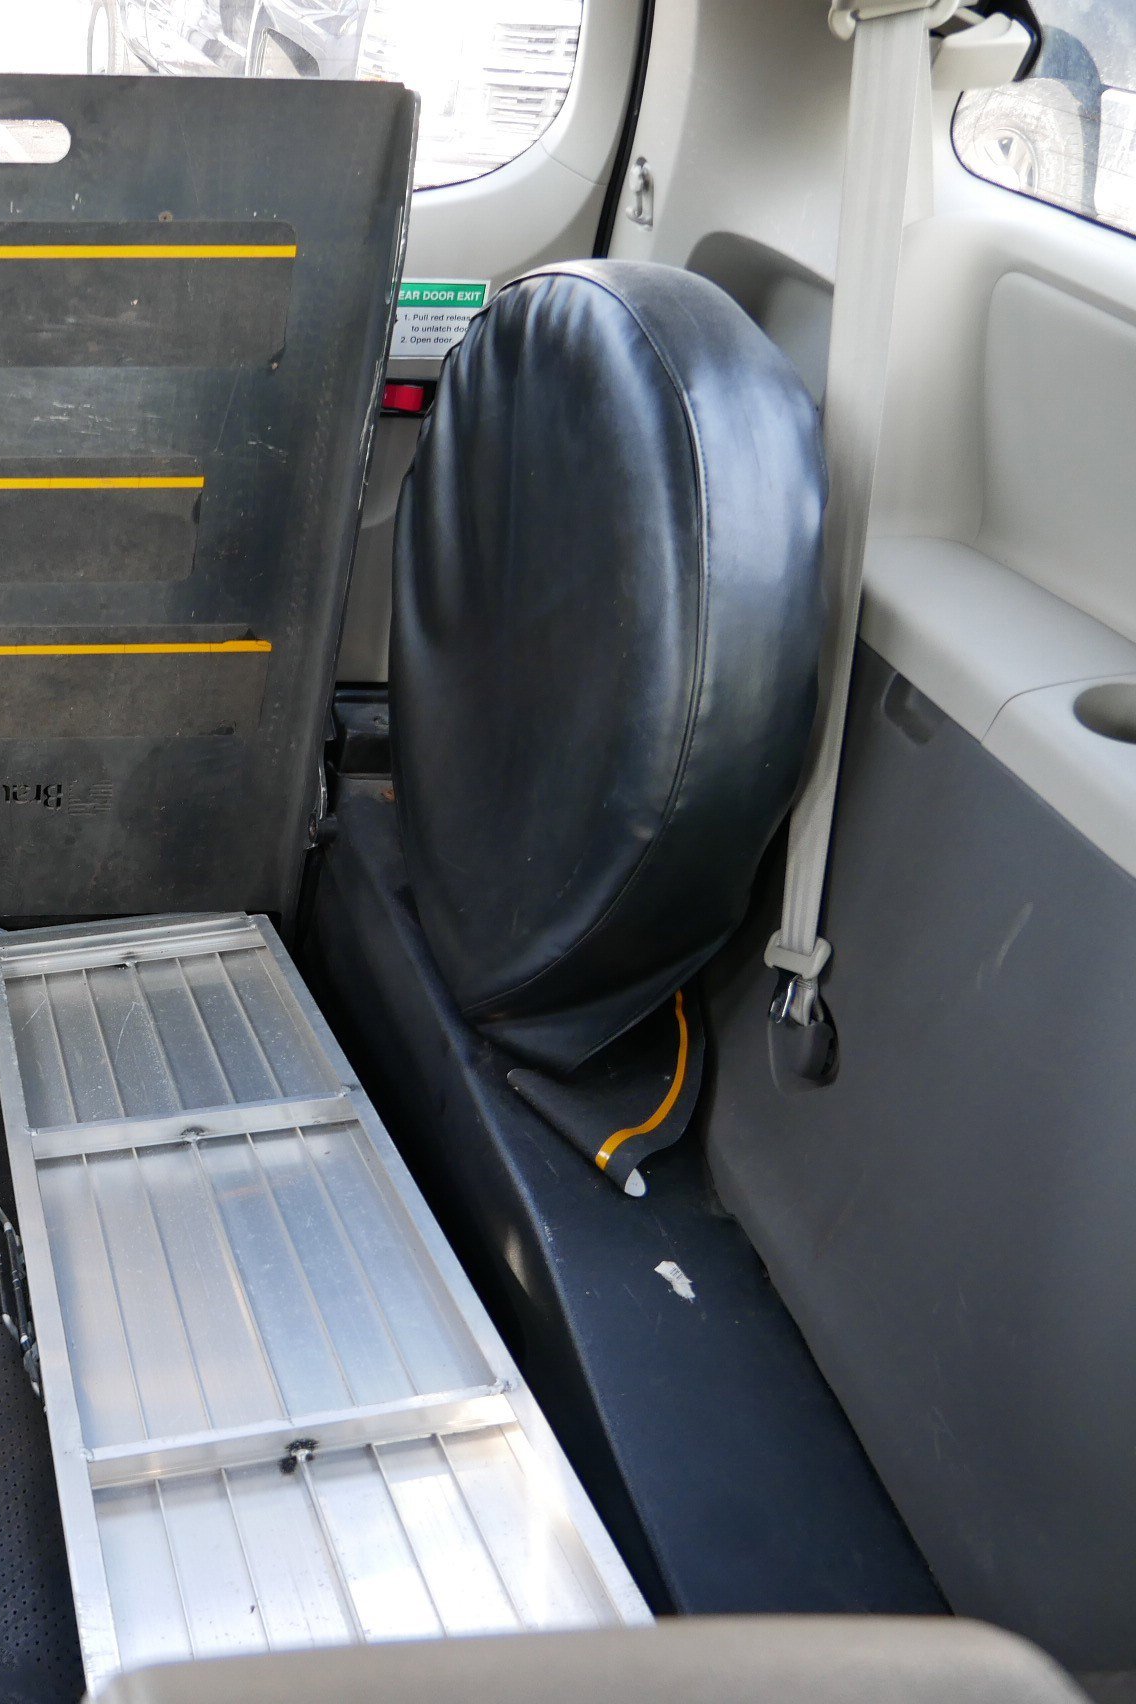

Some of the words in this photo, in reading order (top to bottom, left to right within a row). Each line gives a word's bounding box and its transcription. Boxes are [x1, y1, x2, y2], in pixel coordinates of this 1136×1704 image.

[398, 290, 420, 301] EAR
[423, 290, 454, 301] DOOR
[457, 291, 481, 301] EXIT
